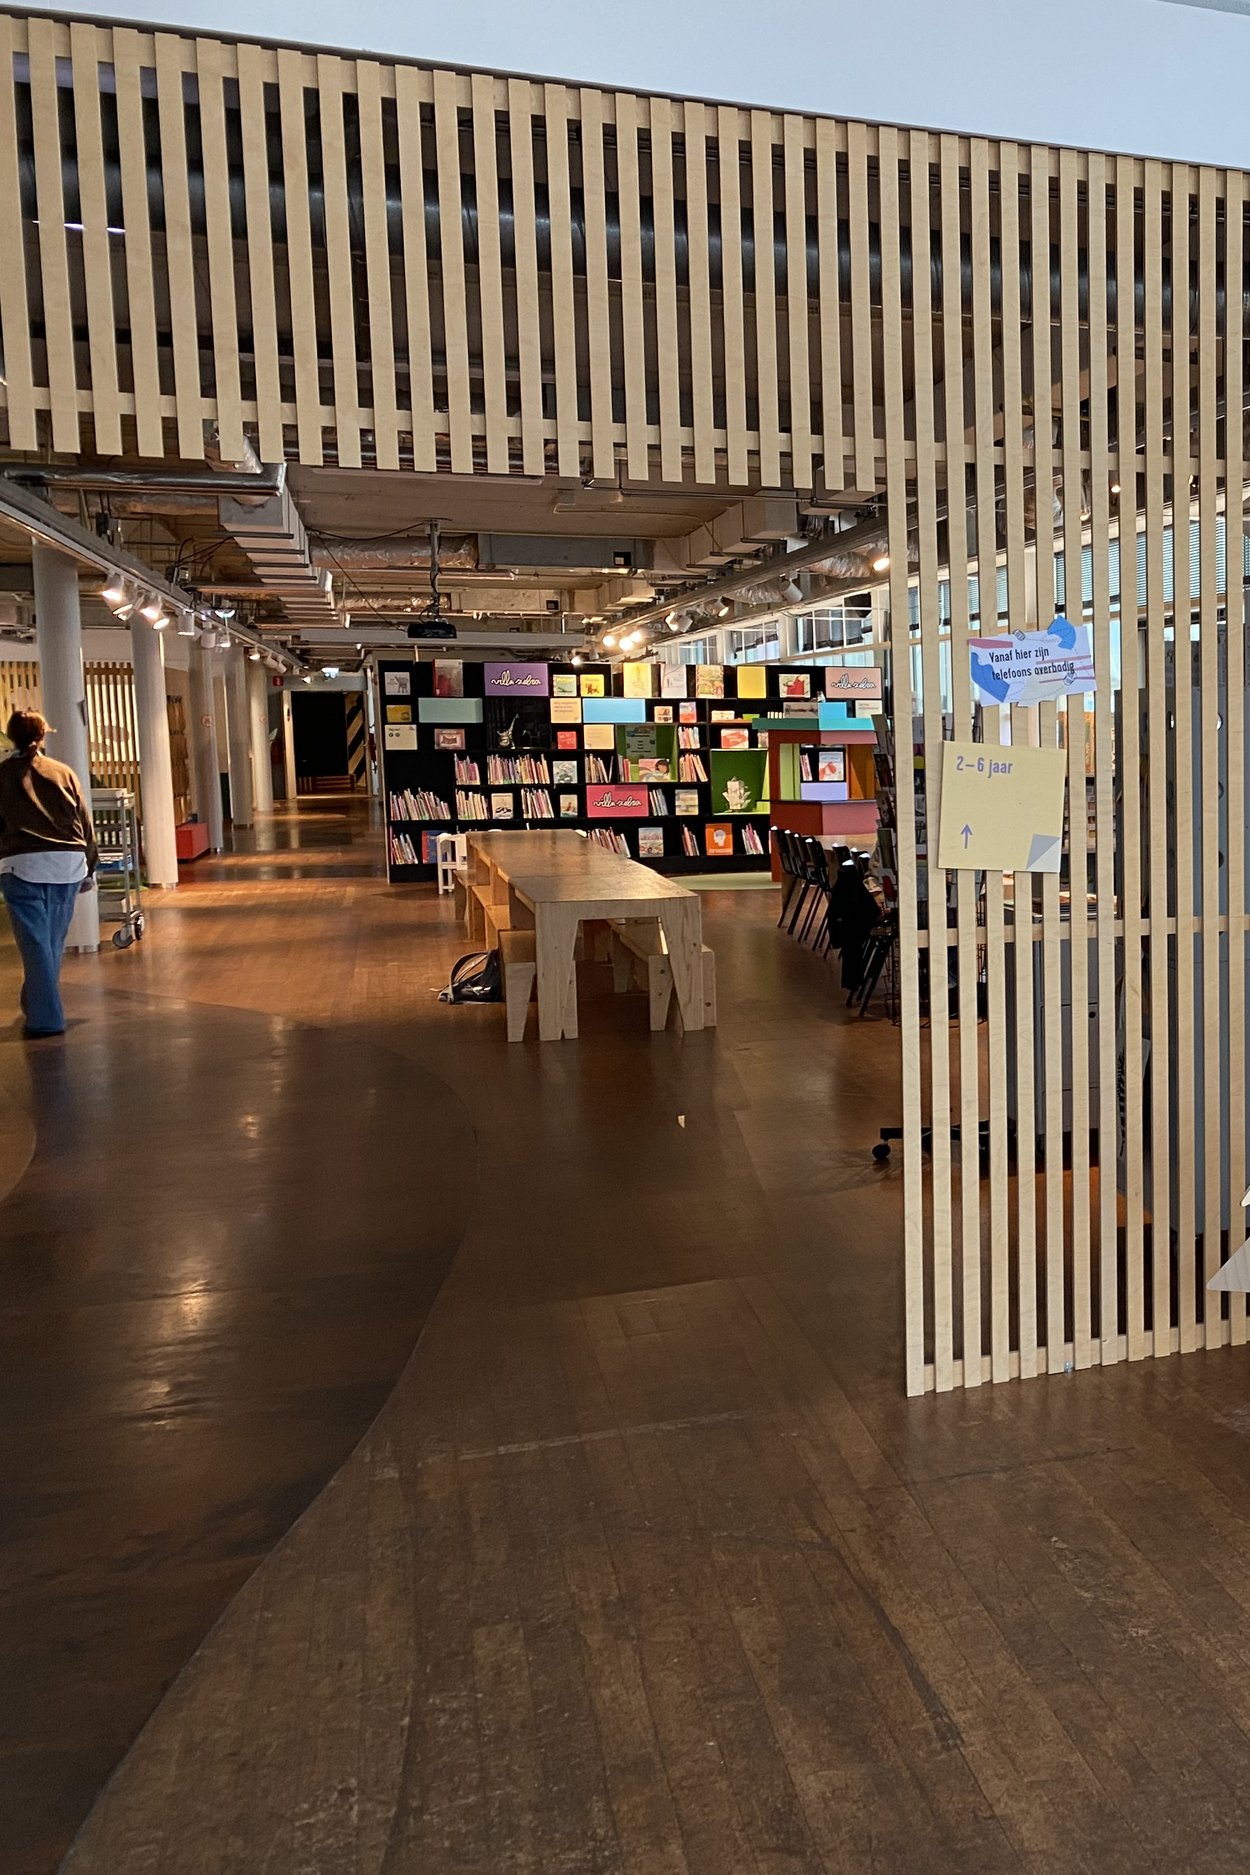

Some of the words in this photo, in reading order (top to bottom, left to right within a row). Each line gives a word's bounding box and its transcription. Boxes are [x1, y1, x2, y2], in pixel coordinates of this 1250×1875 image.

[988, 649, 1013, 663] Vanaf
[1014, 648, 1032, 661] hier
[1034, 646, 1050, 661] zijn
[491, 669, 514, 686] villa
[992, 667, 1032, 681] telefoons
[1034, 660, 1076, 675] overbodig
[831, 673, 851, 689] villa
[987, 759, 1013, 779] jaar
[593, 791, 615, 808] villa
